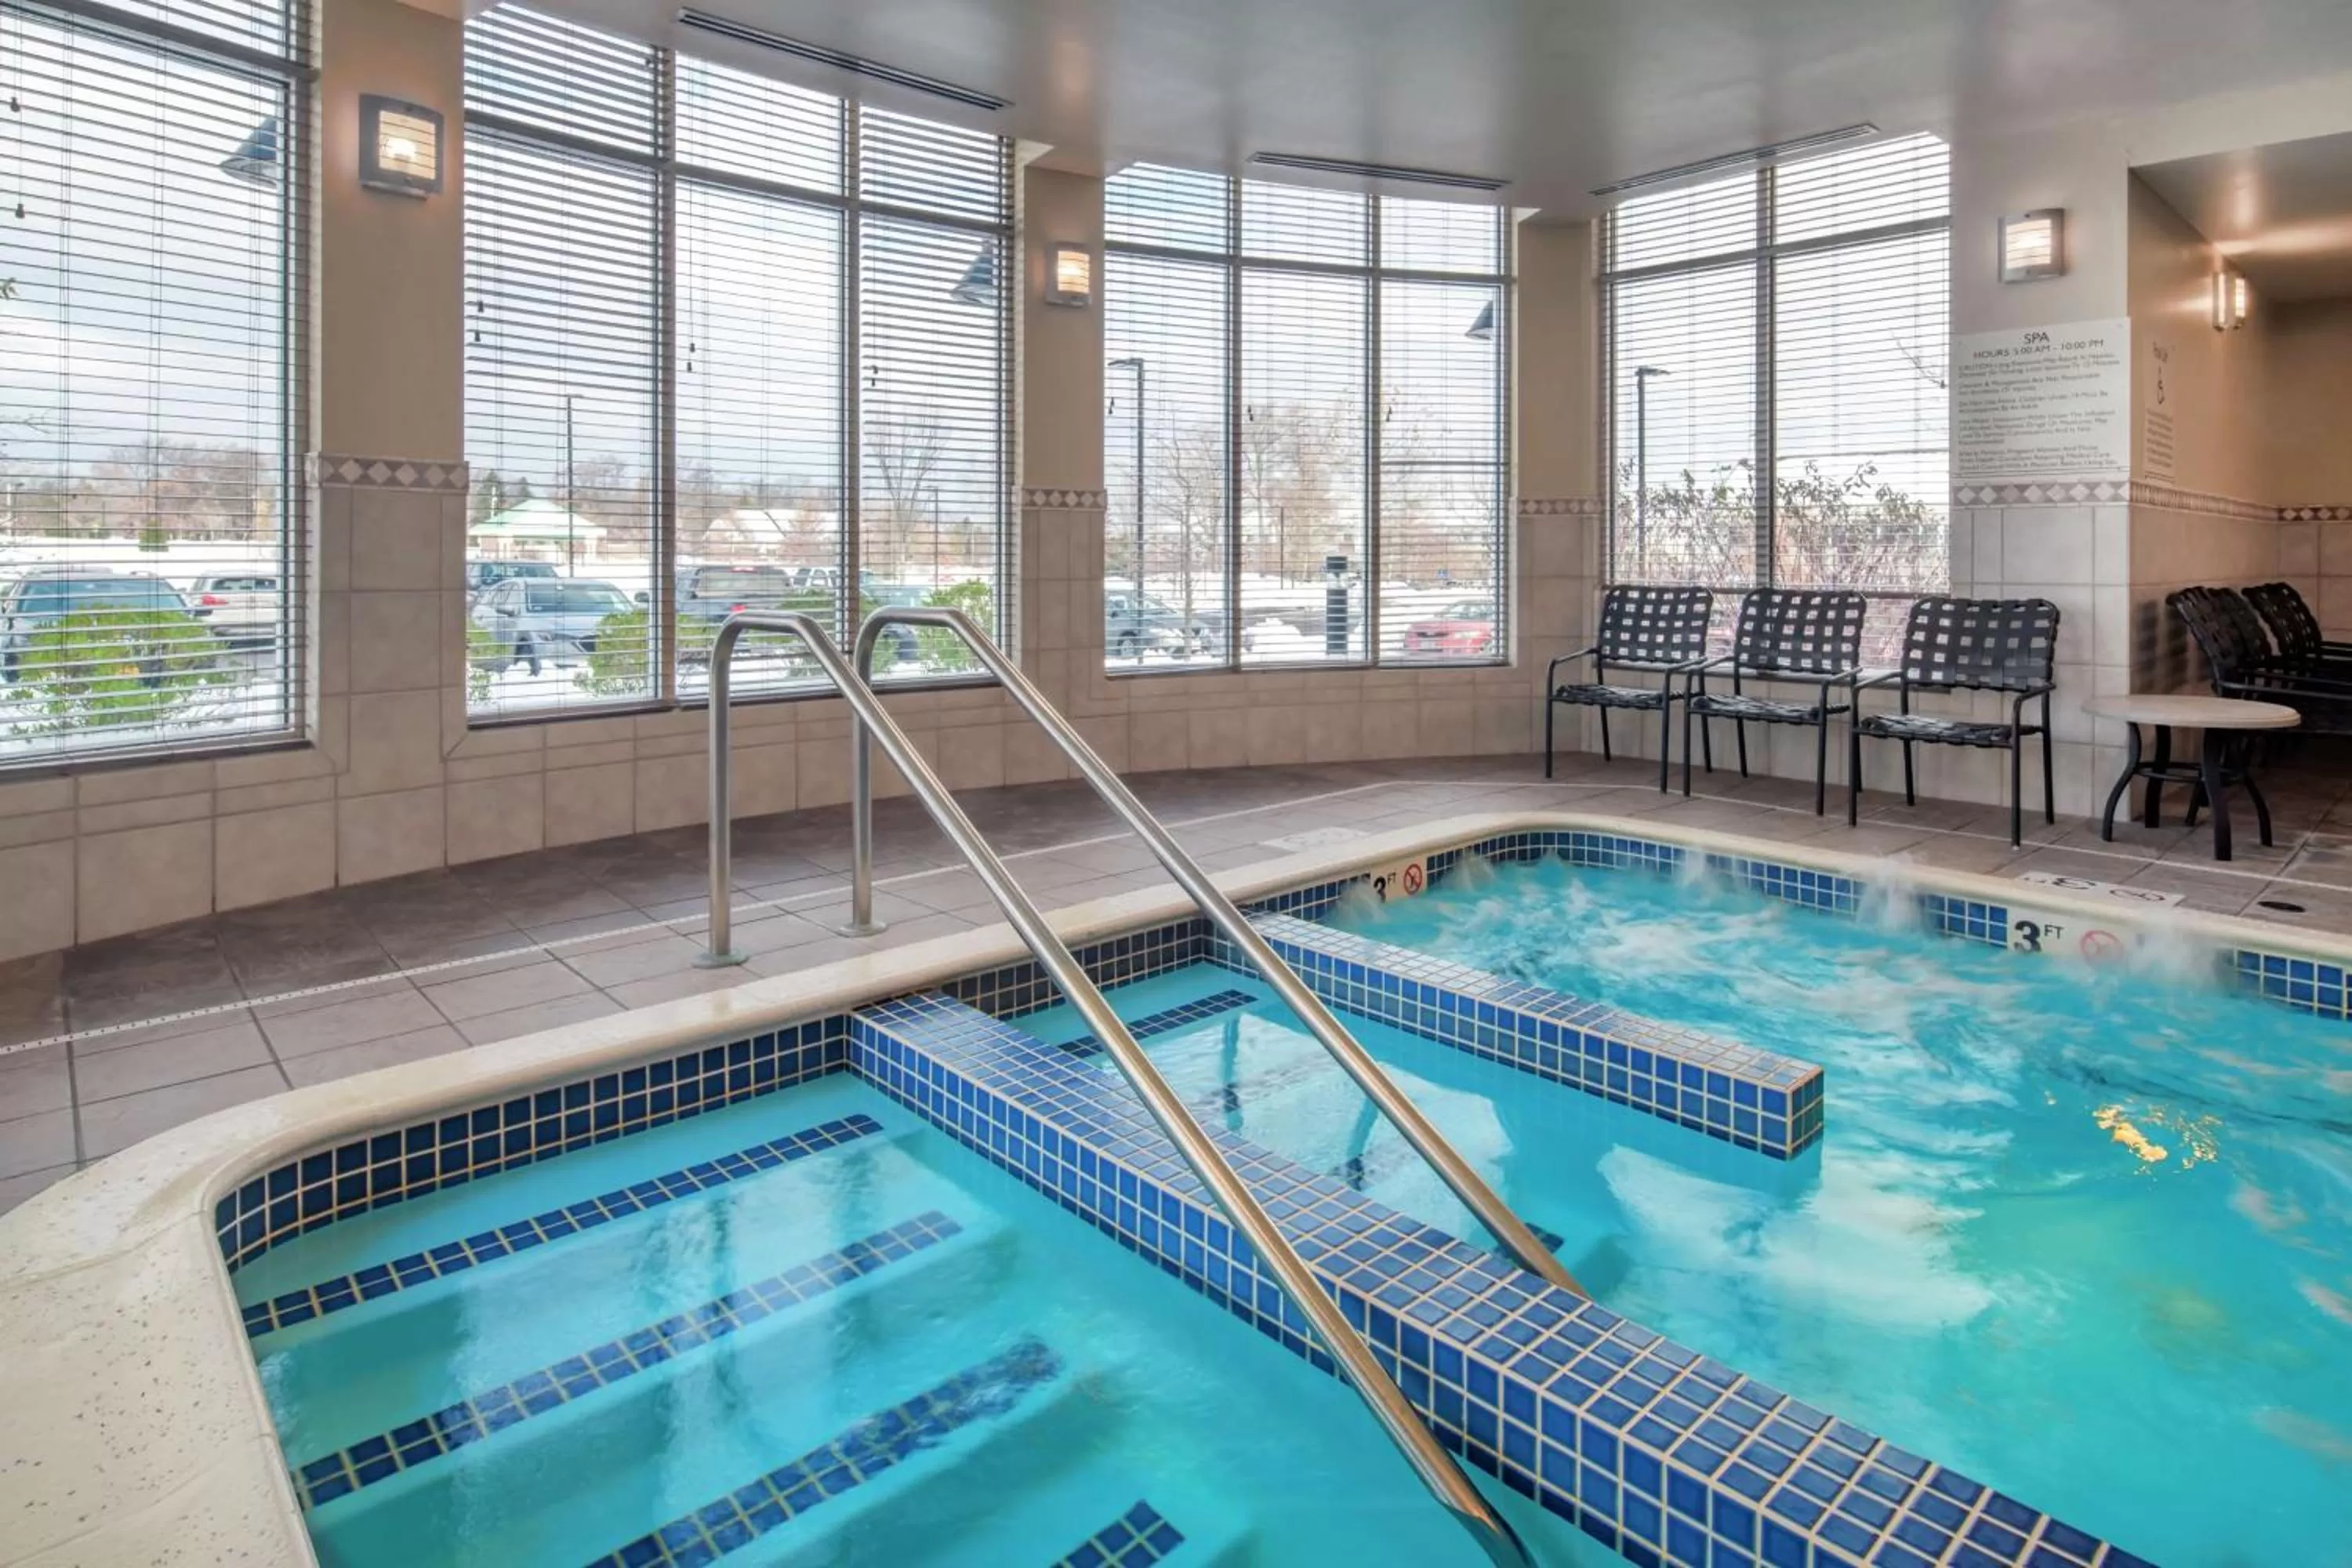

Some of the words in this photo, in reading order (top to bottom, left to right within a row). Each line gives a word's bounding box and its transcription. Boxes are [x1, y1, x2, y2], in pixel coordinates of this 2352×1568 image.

[1973, 348, 2010, 358] HOURS
[2034, 344, 2051, 353] AM
[2089, 338, 2104, 347] PM
[2024, 332, 2050, 345] SPA
[2014, 920, 2042, 953] 3
[2044, 924, 2063, 940] FT
